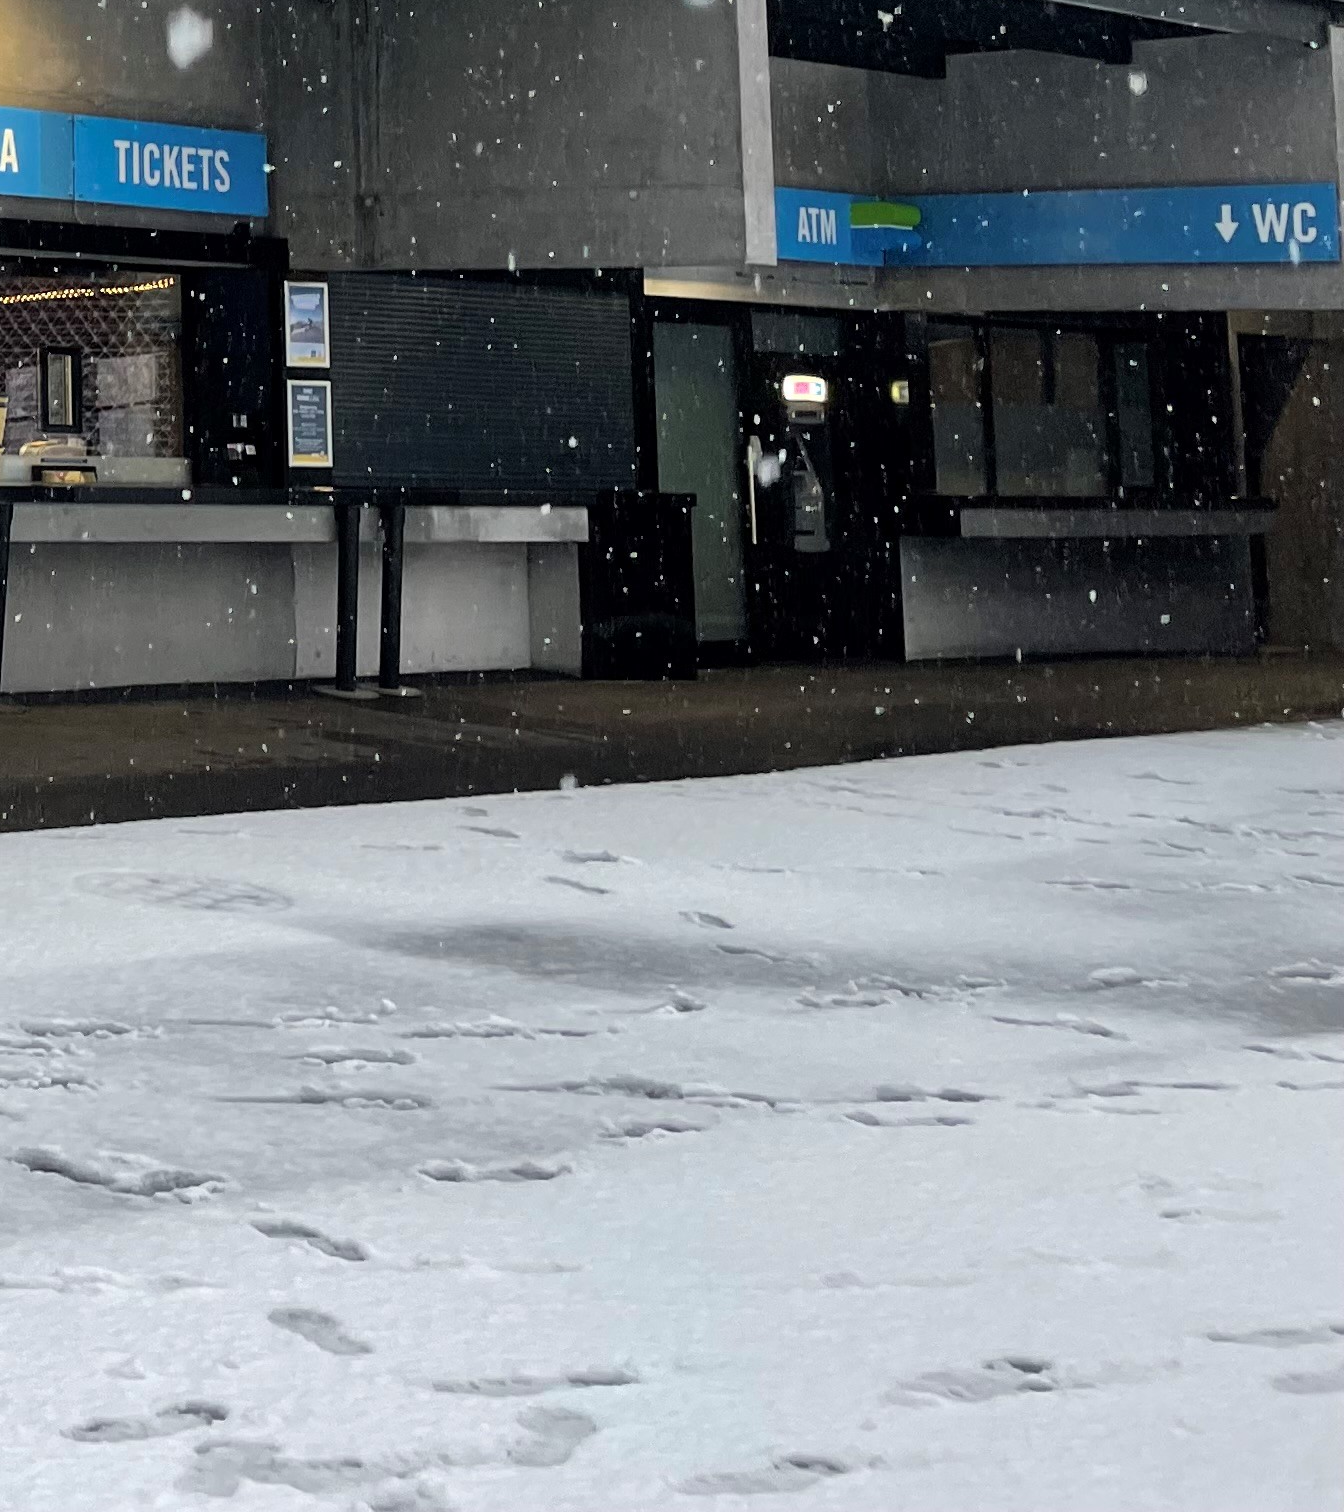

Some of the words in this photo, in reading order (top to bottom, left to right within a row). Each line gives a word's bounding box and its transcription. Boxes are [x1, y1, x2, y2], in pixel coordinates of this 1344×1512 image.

[113, 139, 231, 194] TICKETS
[797, 206, 837, 246] ATM
[1252, 202, 1318, 244] WC
